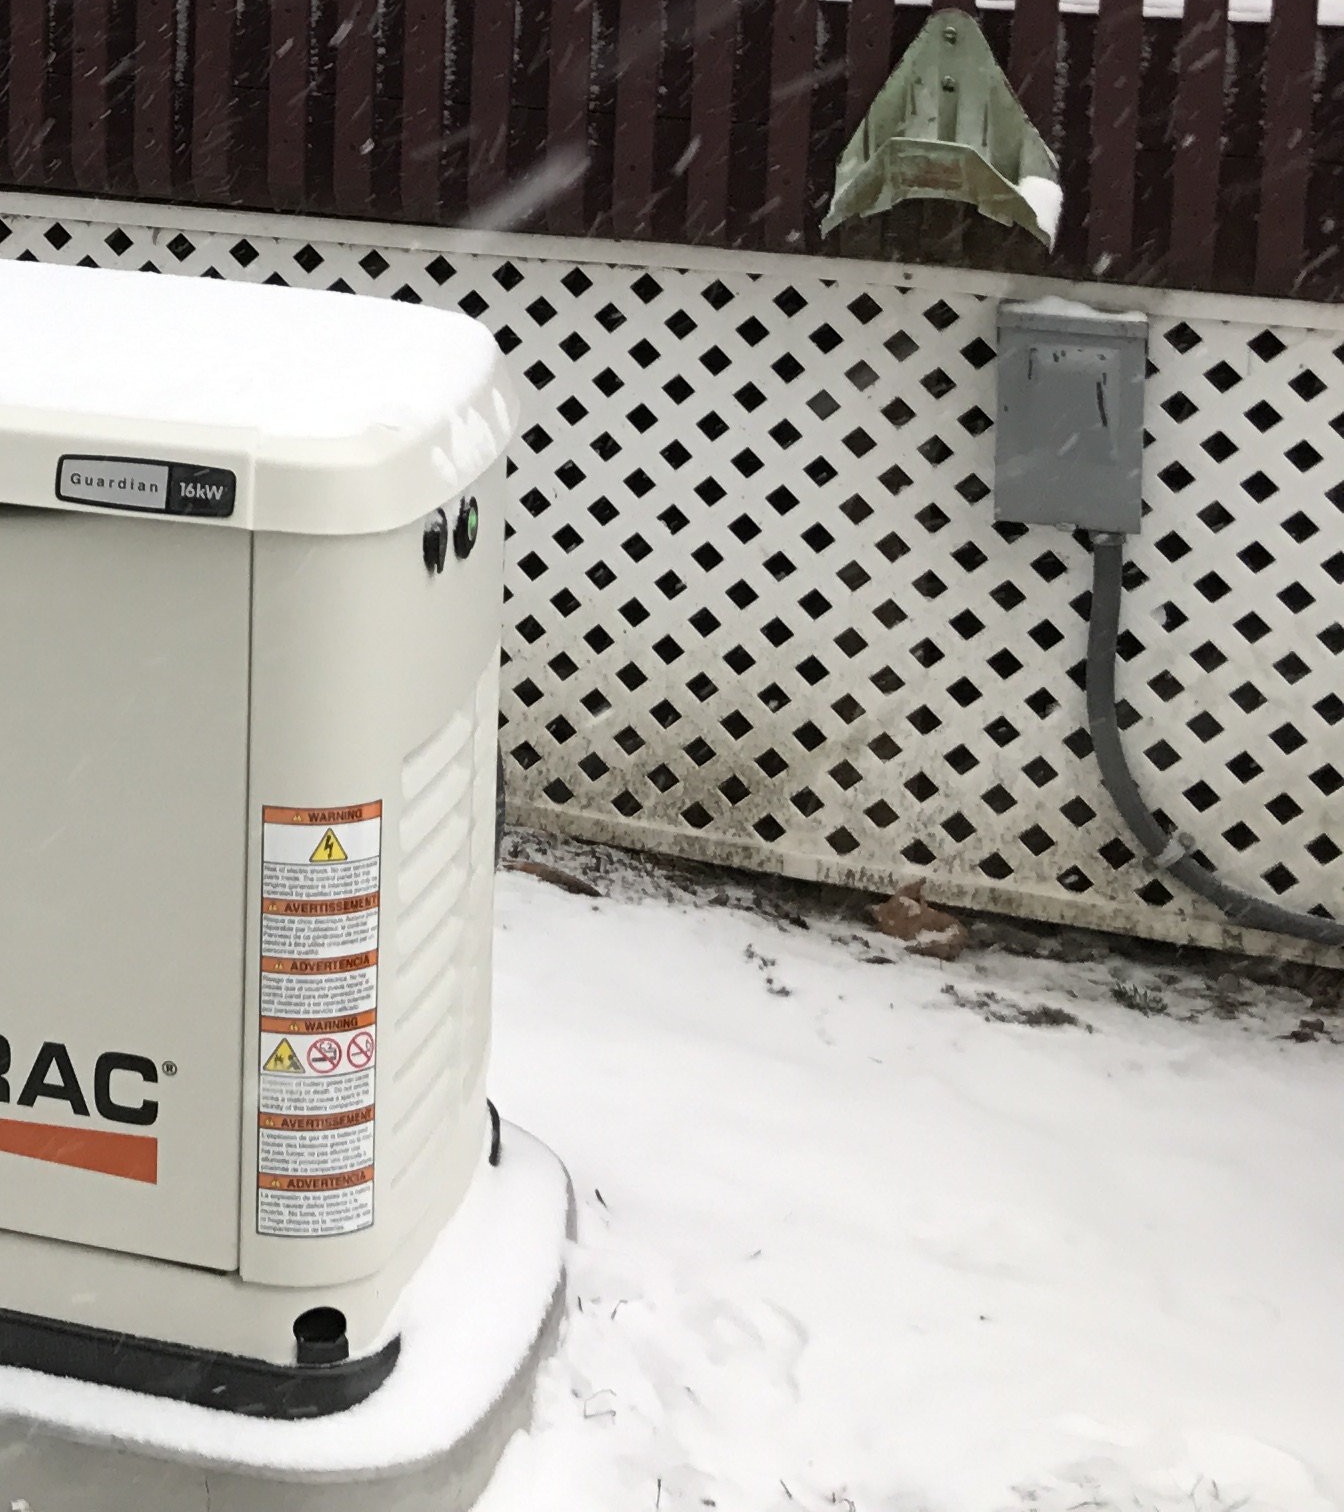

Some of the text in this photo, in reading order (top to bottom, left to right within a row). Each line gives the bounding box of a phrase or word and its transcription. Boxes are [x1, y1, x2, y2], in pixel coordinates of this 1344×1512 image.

[70, 472, 224, 502] Guardian 16kW
[308, 808, 362, 822] WARNING
[284, 896, 377, 914] AVERTISSEMENT
[290, 955, 370, 971] ADVERTENCIA
[305, 1017, 359, 1032] WARNING
[281, 1110, 372, 1129] AVERTISSEMENT
